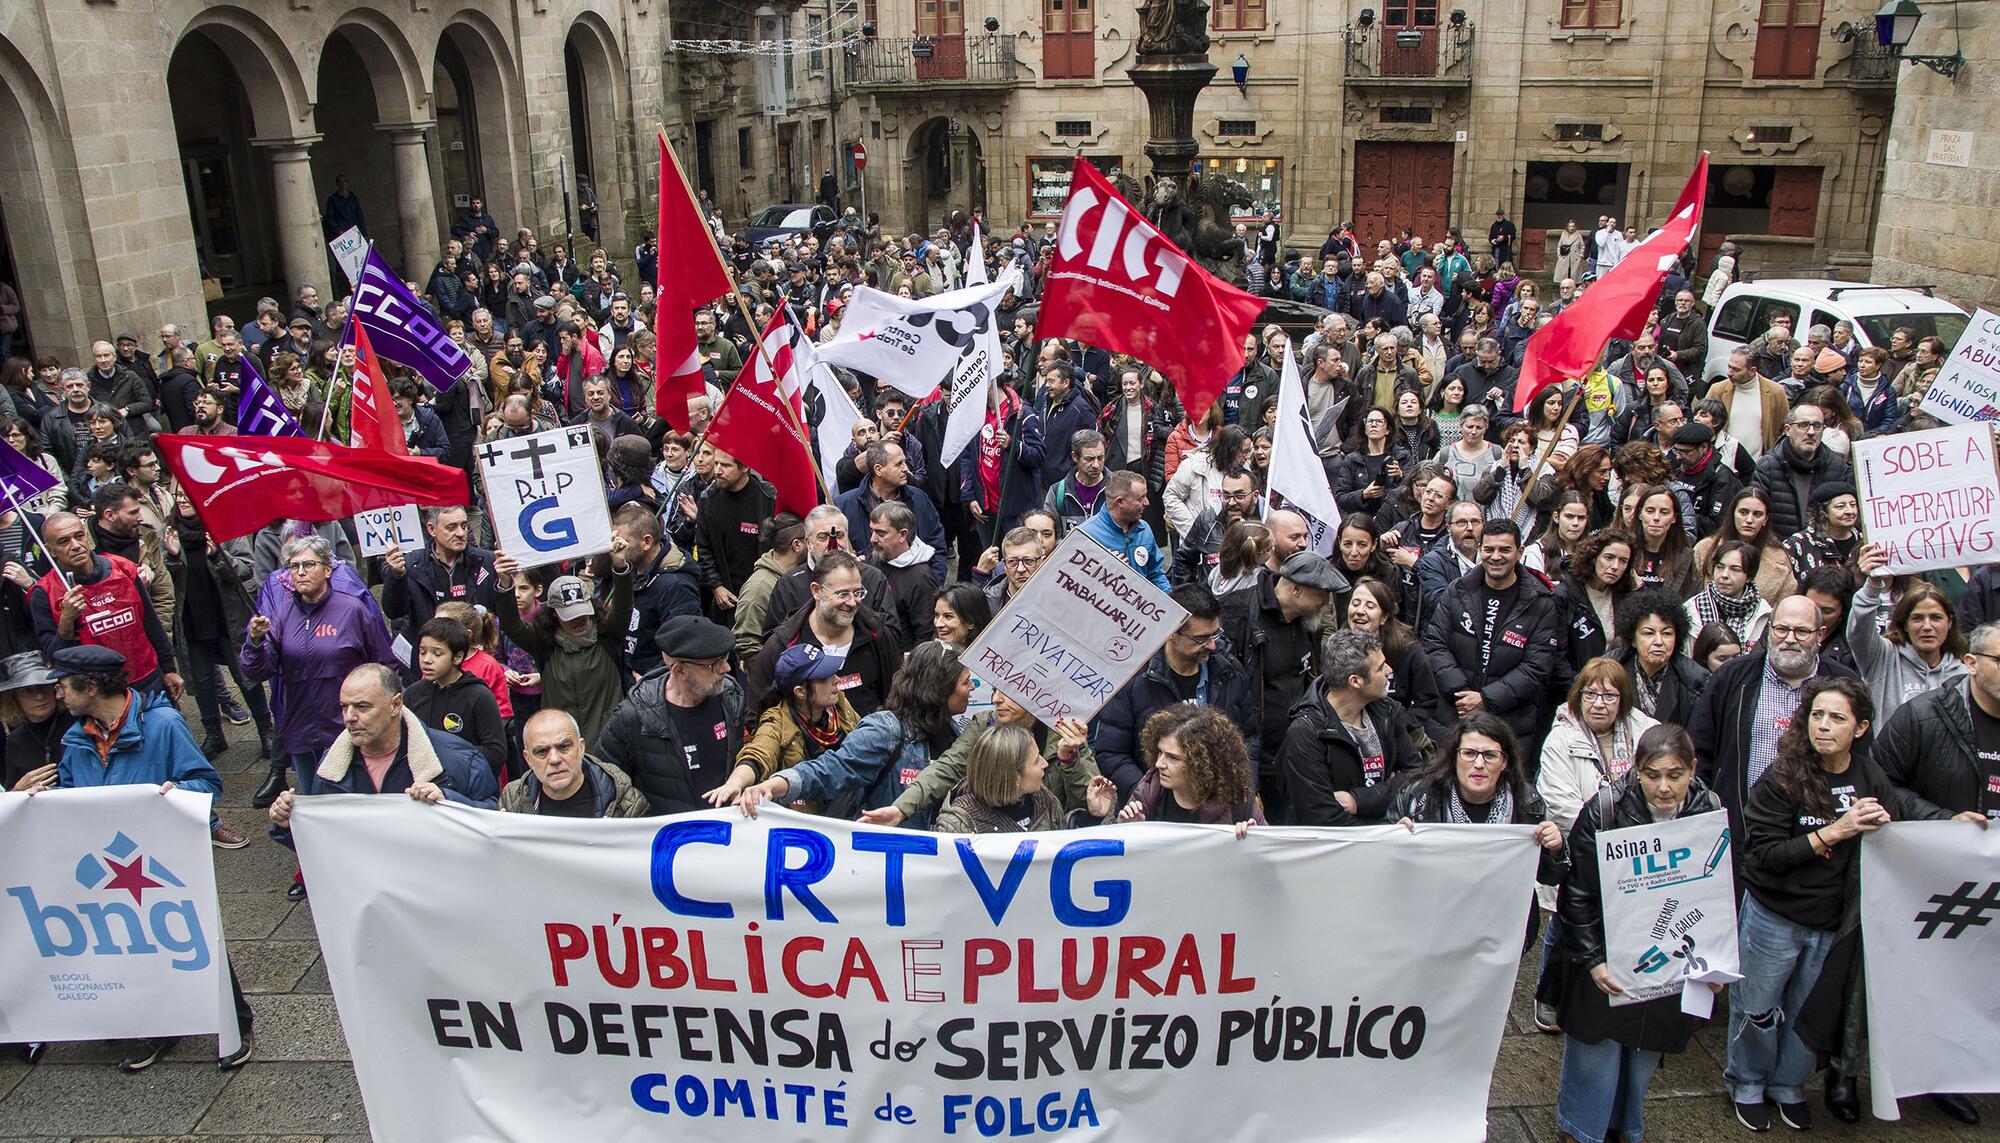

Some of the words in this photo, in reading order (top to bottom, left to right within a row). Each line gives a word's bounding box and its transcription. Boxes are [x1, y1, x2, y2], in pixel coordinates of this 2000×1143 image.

[1940, 134, 1961, 144] PRAZA
[1058, 187, 1188, 298] CIG
[354, 283, 464, 366] CCOO
[1949, 373, 1960, 384] A
[1964, 380, 1998, 403] NOSA
[1883, 440, 1952, 476] SOBE
[1966, 437, 1986, 465] A
[361, 510, 402, 526] TODO
[518, 495, 579, 552] G
[1867, 486, 1996, 529] TEMPERATURA
[366, 526, 415, 547] MAL
[1906, 519, 1994, 566] CRTVG
[1056, 570, 1147, 641] TRABALLAR!!!
[1069, 549, 1166, 623] DEIXÁDENOS
[92, 611, 133, 632] CCOO
[1484, 598, 1500, 639] JEANS
[1011, 614, 1114, 704] PRIVATIZAR
[979, 646, 1072, 719] PREVARICAR
[716, 730, 727, 740] FO
[1606, 838, 1648, 861] Asina
[1653, 838, 1662, 853] a
[1632, 847, 1692, 876] ILP
[650, 820, 1132, 927] CRTVG
[1617, 877, 1638, 885] Contra
[1667, 874, 1687, 882] Galega
[6, 885, 211, 971] bng
[1650, 897, 1680, 941] LIBEREMOS
[1669, 928, 1677, 941] A
[1675, 908, 1705, 934] GALEGA
[50, 973, 93, 983] BLOQUE
[544, 913, 890, 1003] PÚBLICA
[901, 940, 945, 1003] E
[963, 932, 1256, 1004] PLURAL
[54, 982, 126, 992] NACIONALISTA
[57, 992, 98, 1001] GALEGO
[426, 998, 523, 1052] EN
[544, 1001, 854, 1073] DEFENSA
[869, 1018, 927, 1062] do
[934, 1007, 1199, 1081] SERVIZO
[1215, 995, 1427, 1067] PÚBLICO
[630, 1073, 849, 1128] COMITÉ
[874, 1092, 917, 1125] de
[943, 1087, 1101, 1137] FOLGA
